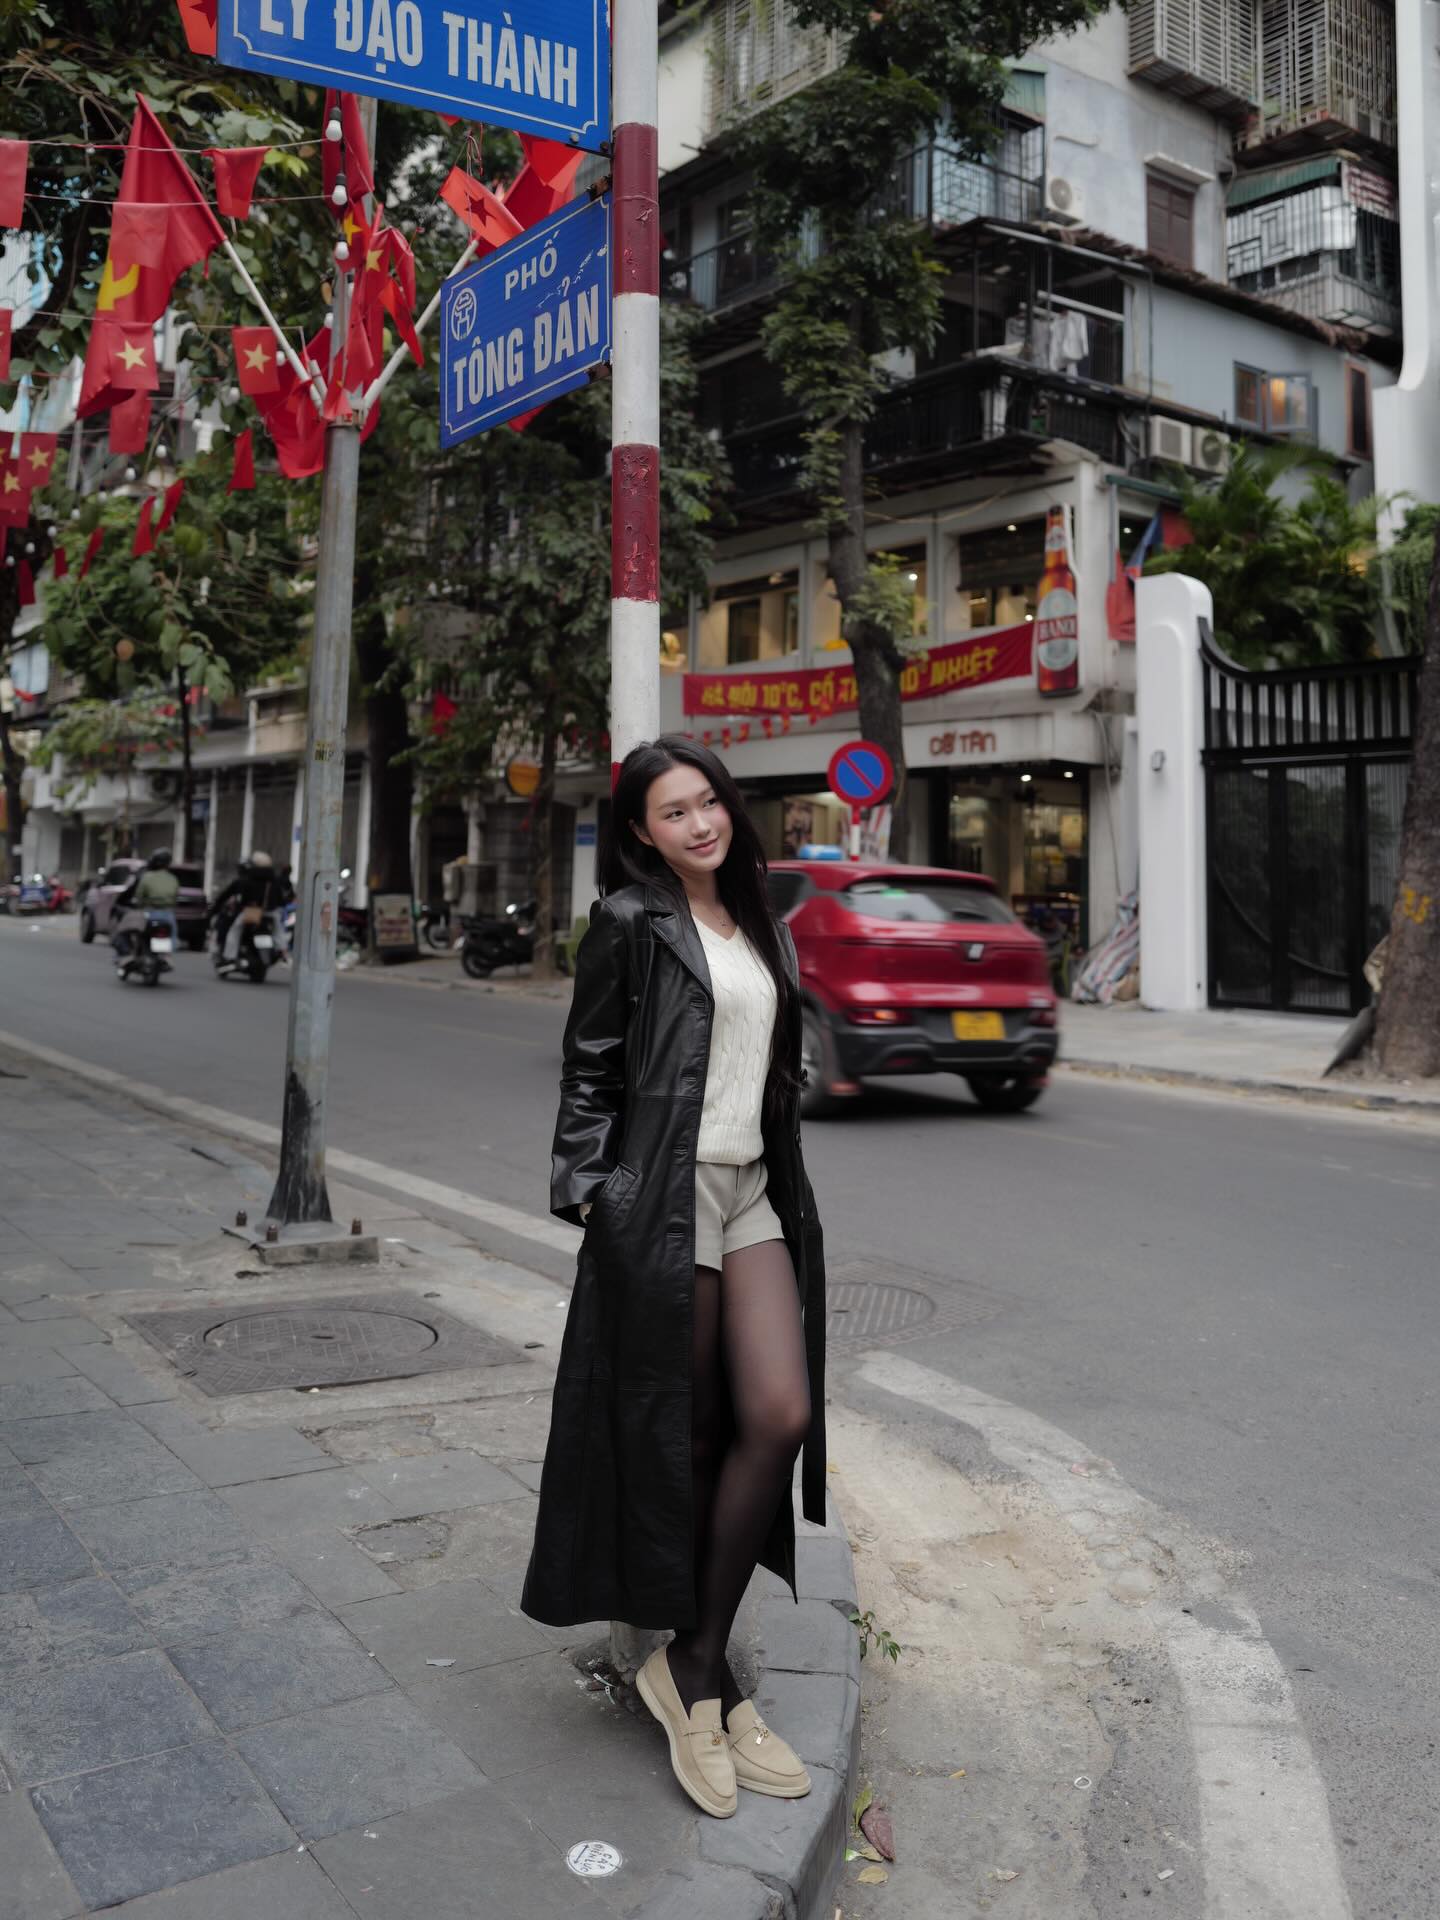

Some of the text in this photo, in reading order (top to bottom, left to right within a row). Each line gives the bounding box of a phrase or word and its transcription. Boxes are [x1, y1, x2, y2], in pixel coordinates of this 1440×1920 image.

[334, 0, 423, 74] ĐẠO
[443, 11, 577, 107] THÀNH
[505, 230, 560, 300] PHỐ
[533, 276, 599, 374] ĐẢN
